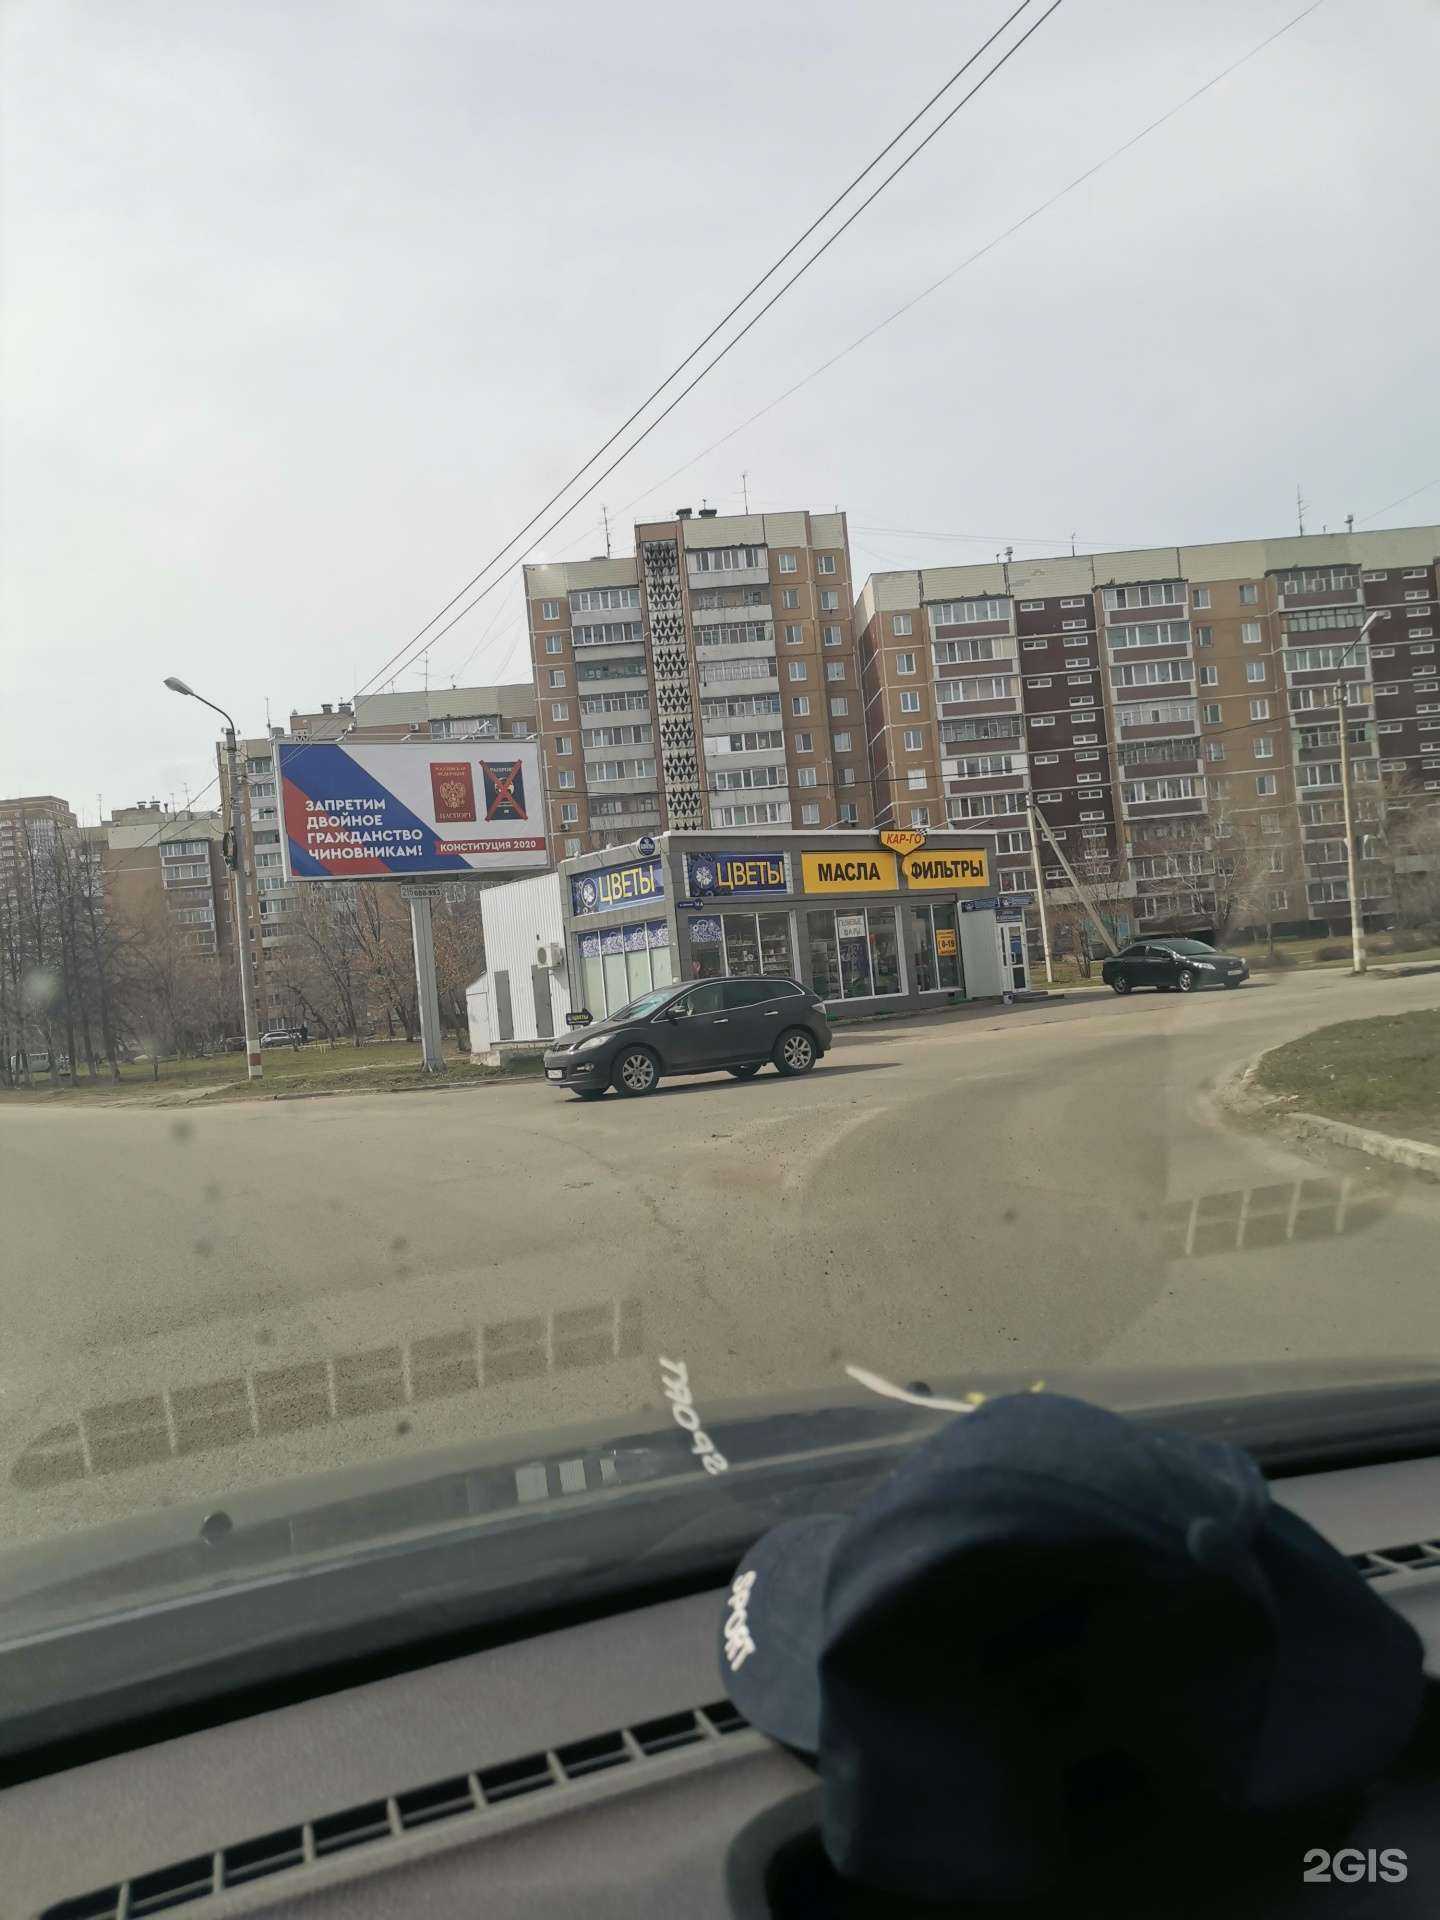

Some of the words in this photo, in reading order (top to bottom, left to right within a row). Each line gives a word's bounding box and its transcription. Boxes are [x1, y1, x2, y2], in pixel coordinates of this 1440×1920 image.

[305, 799, 386, 812] ЗАПРЕТИМ
[306, 811, 384, 830] ДВОЙНОЕ
[307, 829, 423, 845] ГРАЖДАНСТВО
[886, 833, 922, 845] КАР-ГО
[308, 845, 424, 860] ЧИНОВНИКАМ!
[440, 841, 512, 852] КОНСТИТУЦИЯ
[513, 840, 537, 849] 2020
[716, 861, 785, 890] ЦВЕТЫ
[817, 862, 882, 882] МАСЛА
[911, 859, 984, 880] ФИЛЬТРЫ
[598, 865, 656, 905] ЦВЕТЫ
